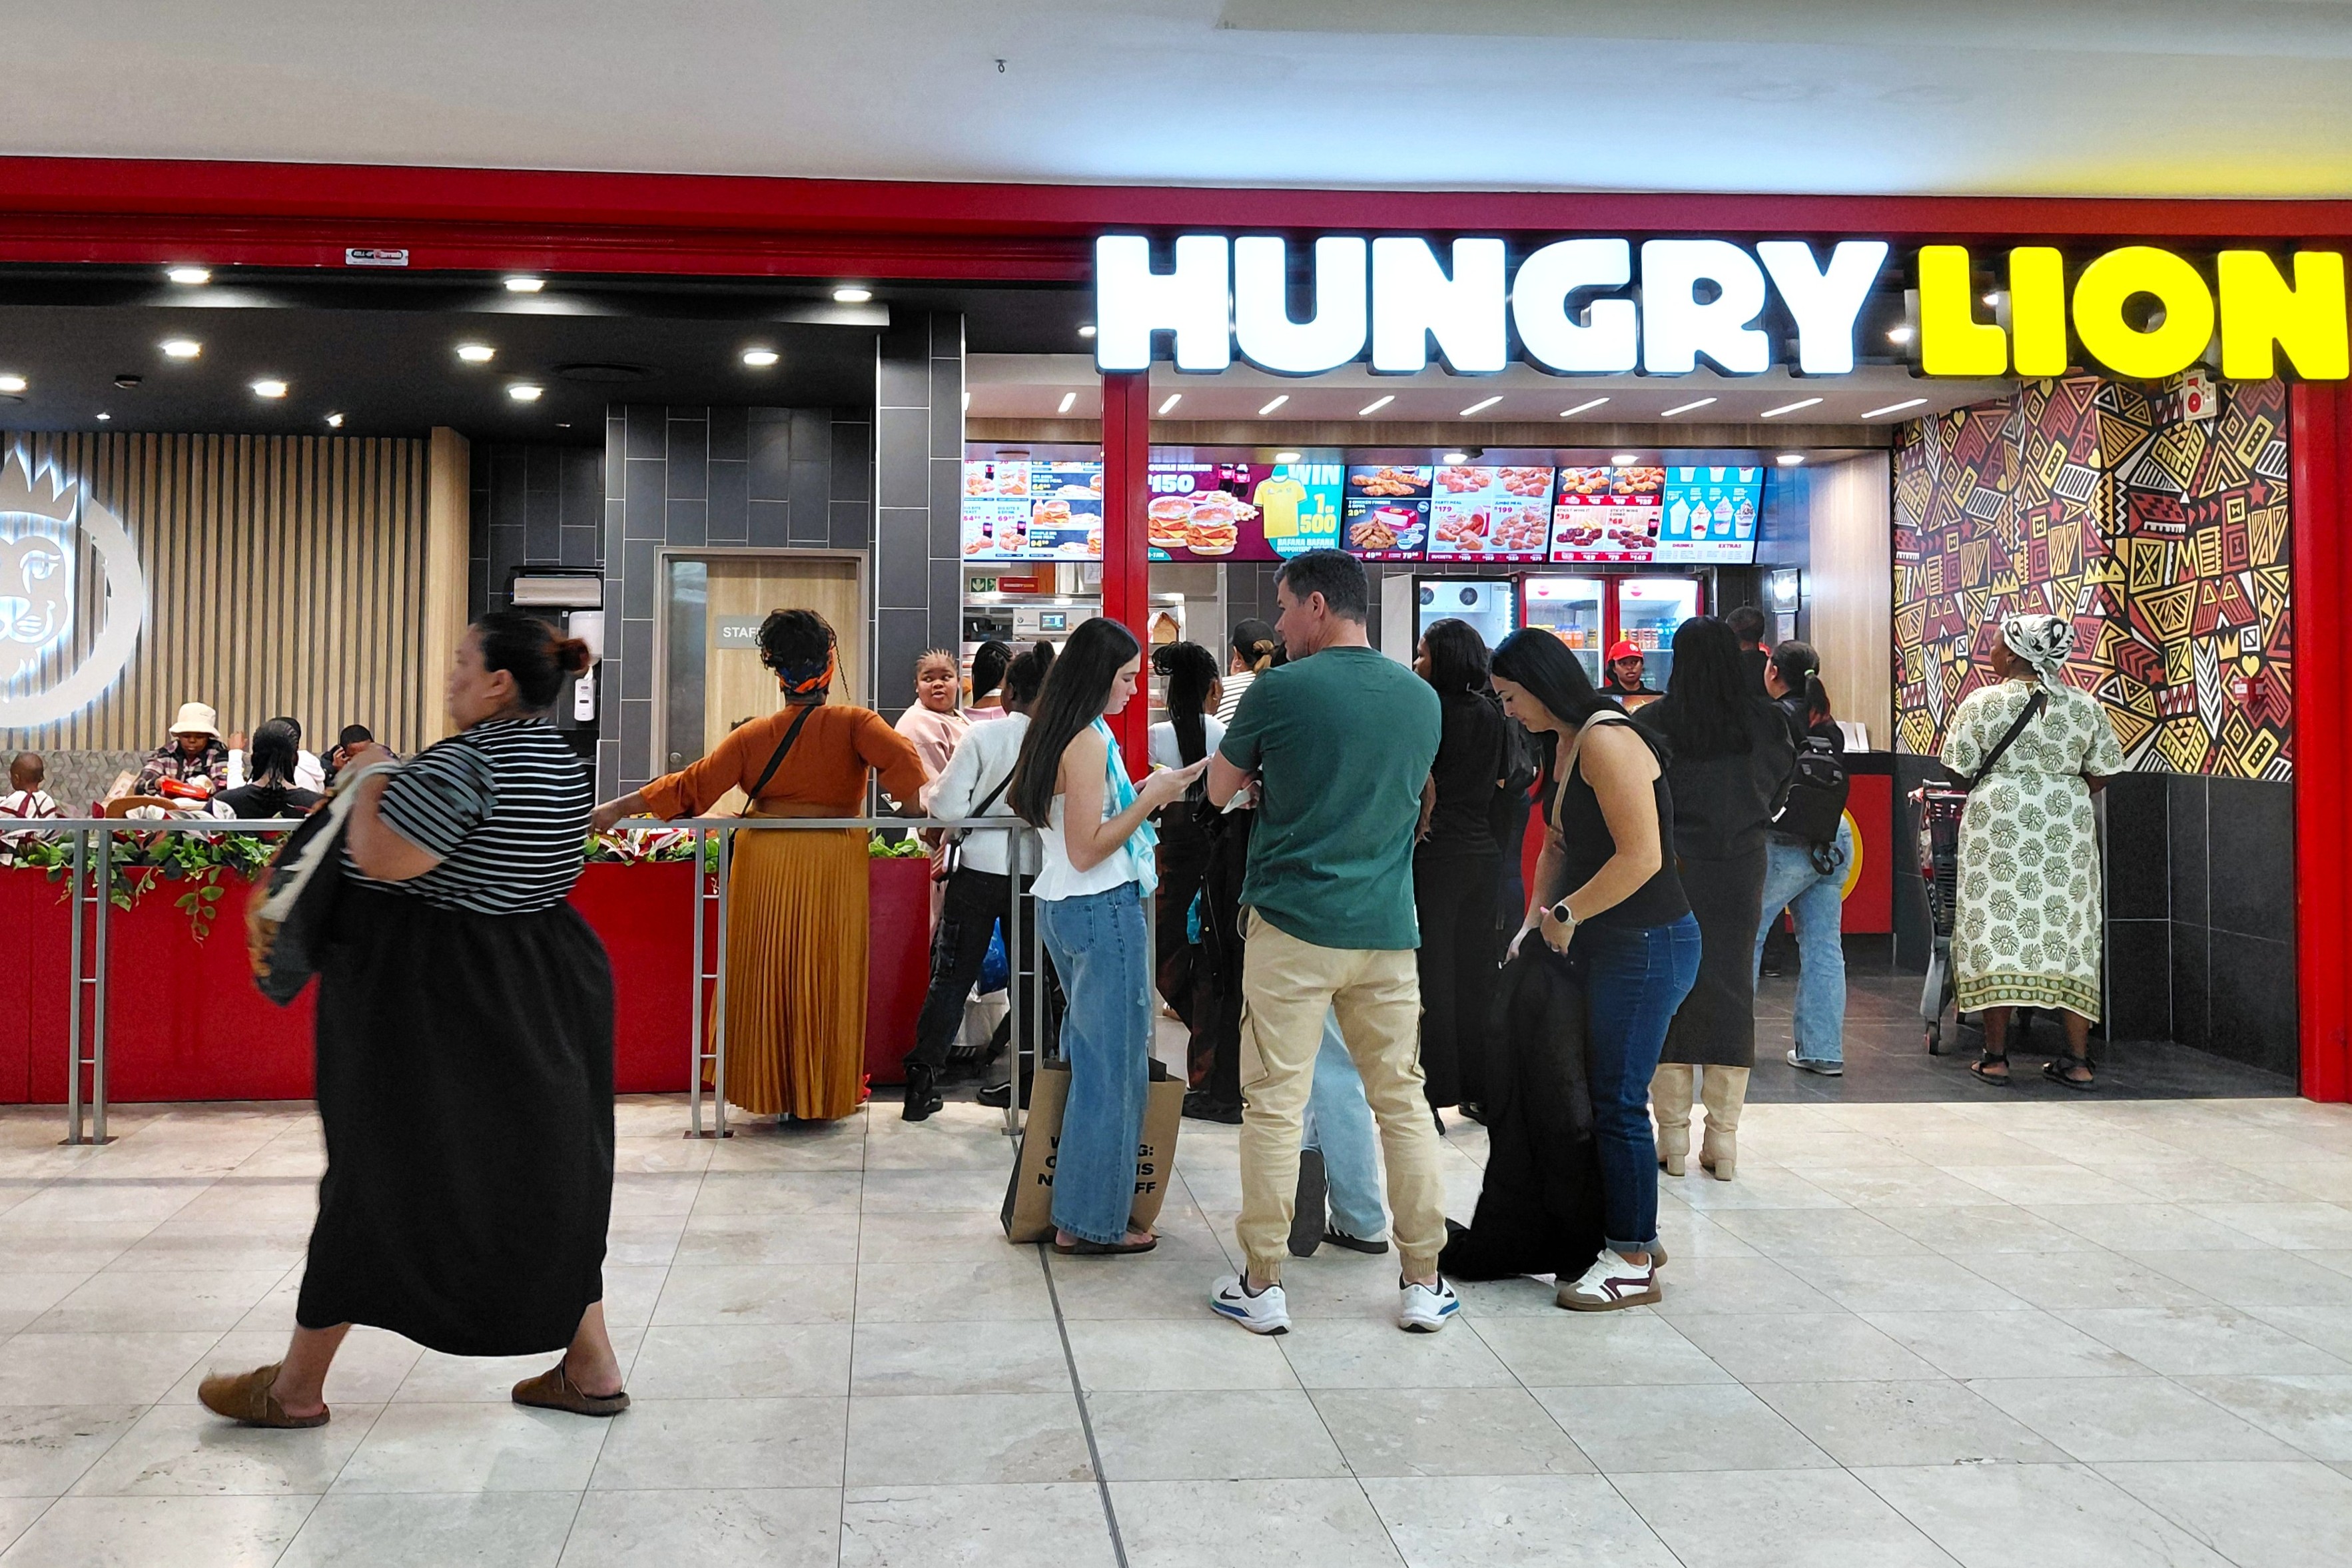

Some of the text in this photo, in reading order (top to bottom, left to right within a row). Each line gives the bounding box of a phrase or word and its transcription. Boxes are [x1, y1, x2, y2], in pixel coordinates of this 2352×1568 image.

[1096, 235, 2350, 380] HUNGRY LION
[1288, 464, 1341, 486] WIN
[1314, 493, 1326, 514] 1
[1300, 514, 1337, 534] 500
